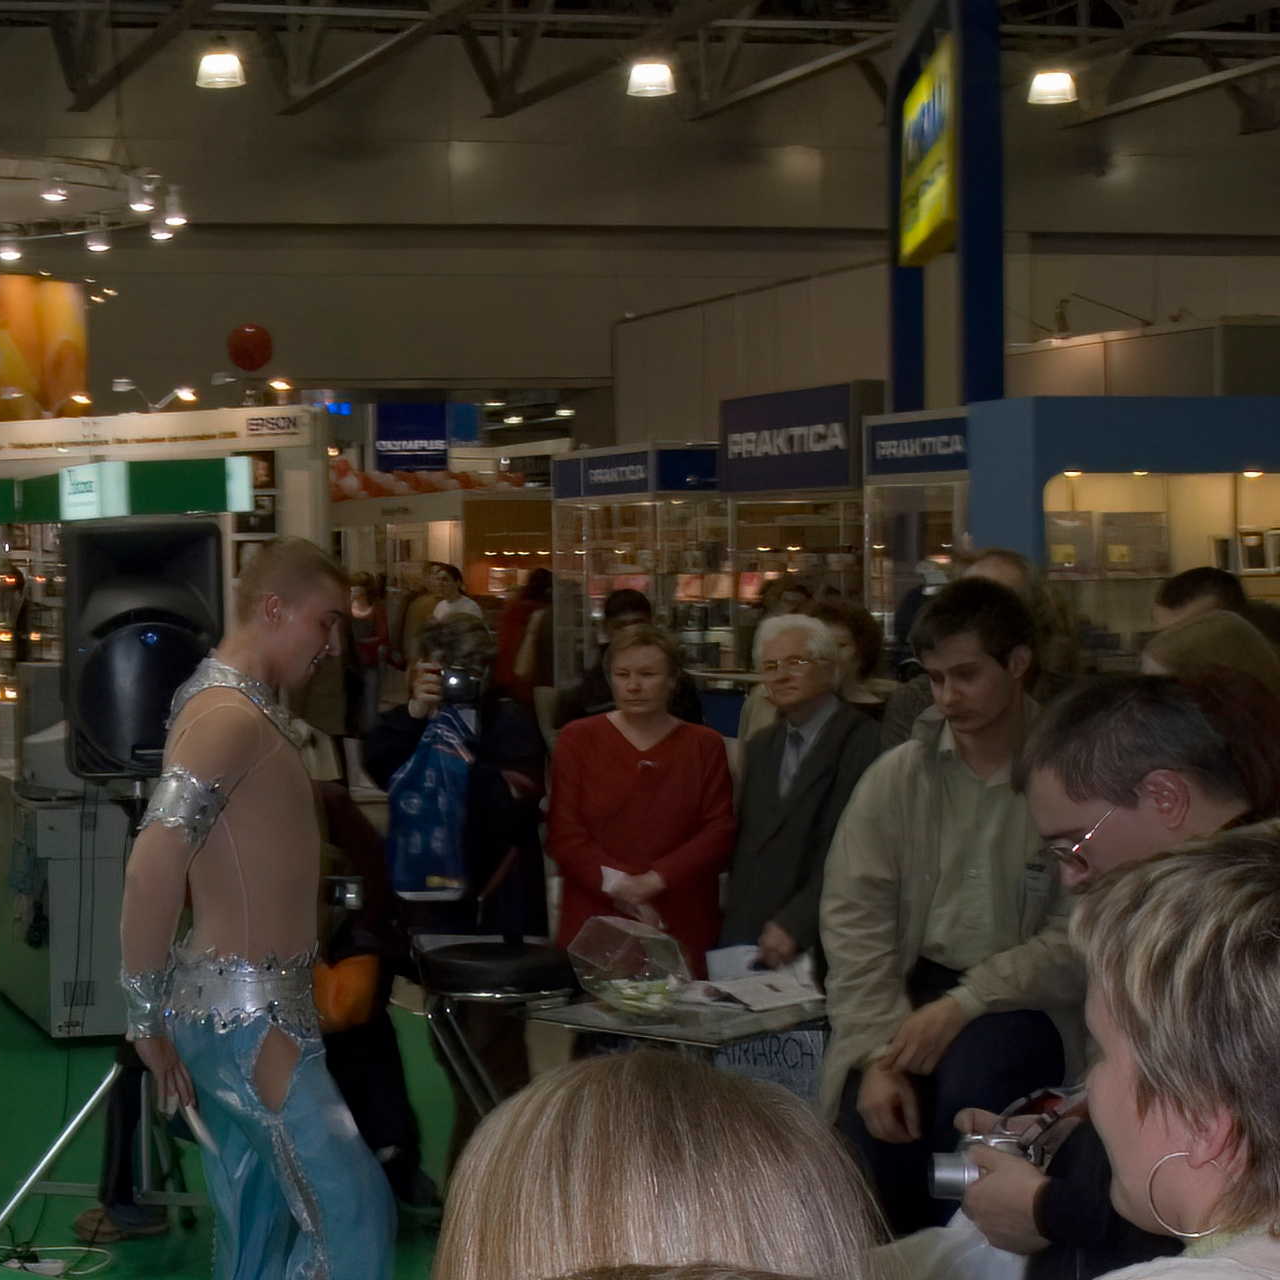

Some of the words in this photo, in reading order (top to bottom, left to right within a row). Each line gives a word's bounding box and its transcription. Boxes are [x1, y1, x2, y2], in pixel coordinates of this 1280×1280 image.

[246, 415, 298, 432] EPSON
[375, 439, 448, 451] OLYMPUS
[727, 422, 847, 460] PRAKTICA
[875, 433, 966, 461] PRAKTICA
[716, 1035, 815, 1070] ATRIARCH
